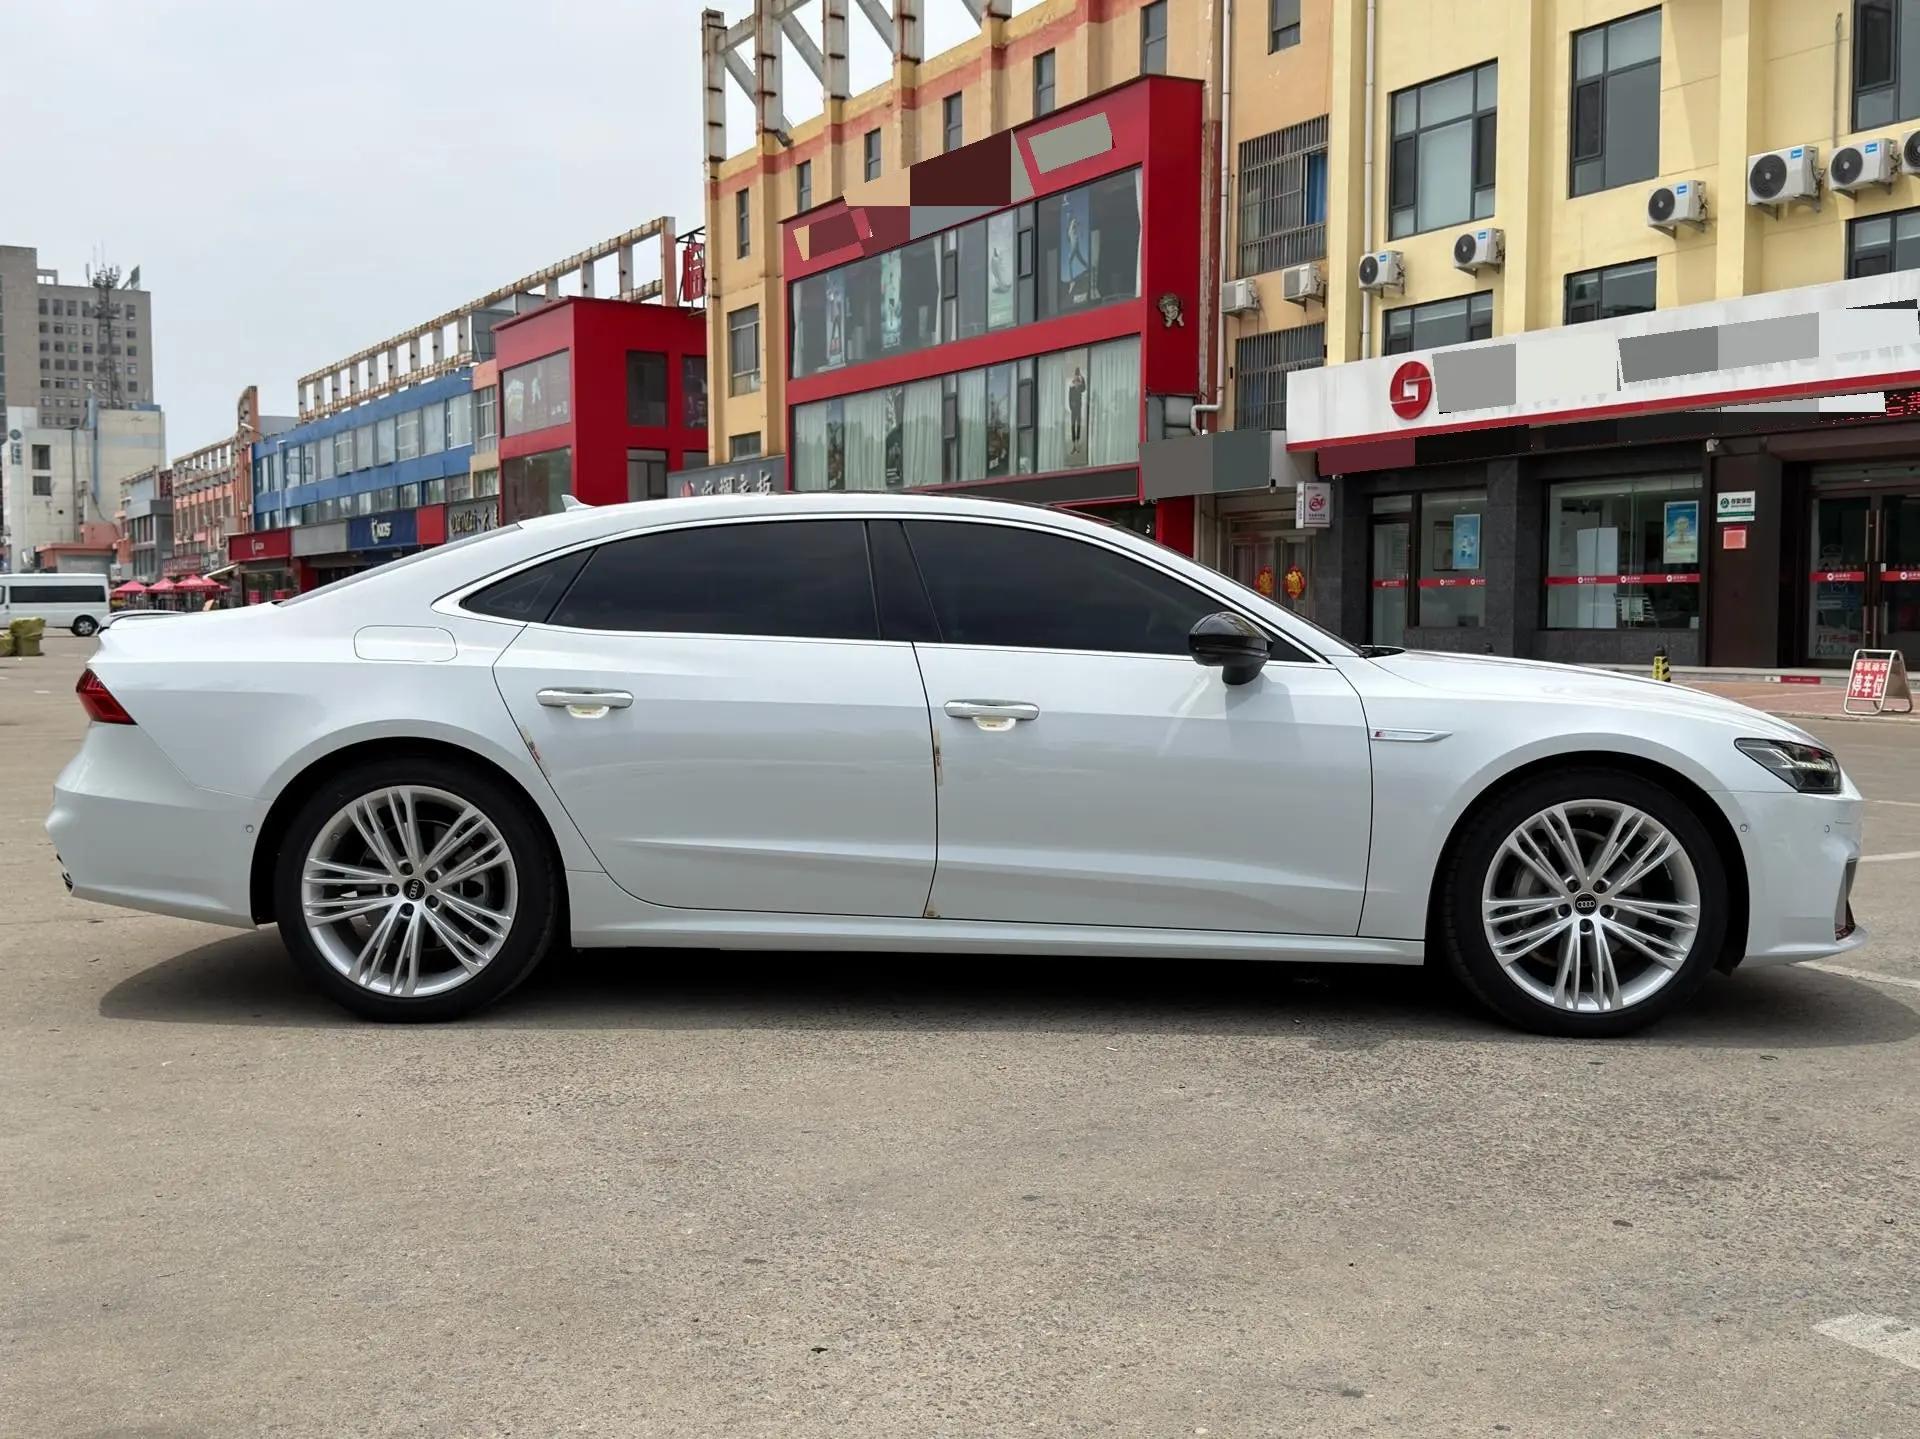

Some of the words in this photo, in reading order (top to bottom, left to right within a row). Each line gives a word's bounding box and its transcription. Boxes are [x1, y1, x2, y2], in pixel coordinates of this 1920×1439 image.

[1855, 661, 1888, 672] 非机动车
[1850, 672, 1885, 698] 停车位
